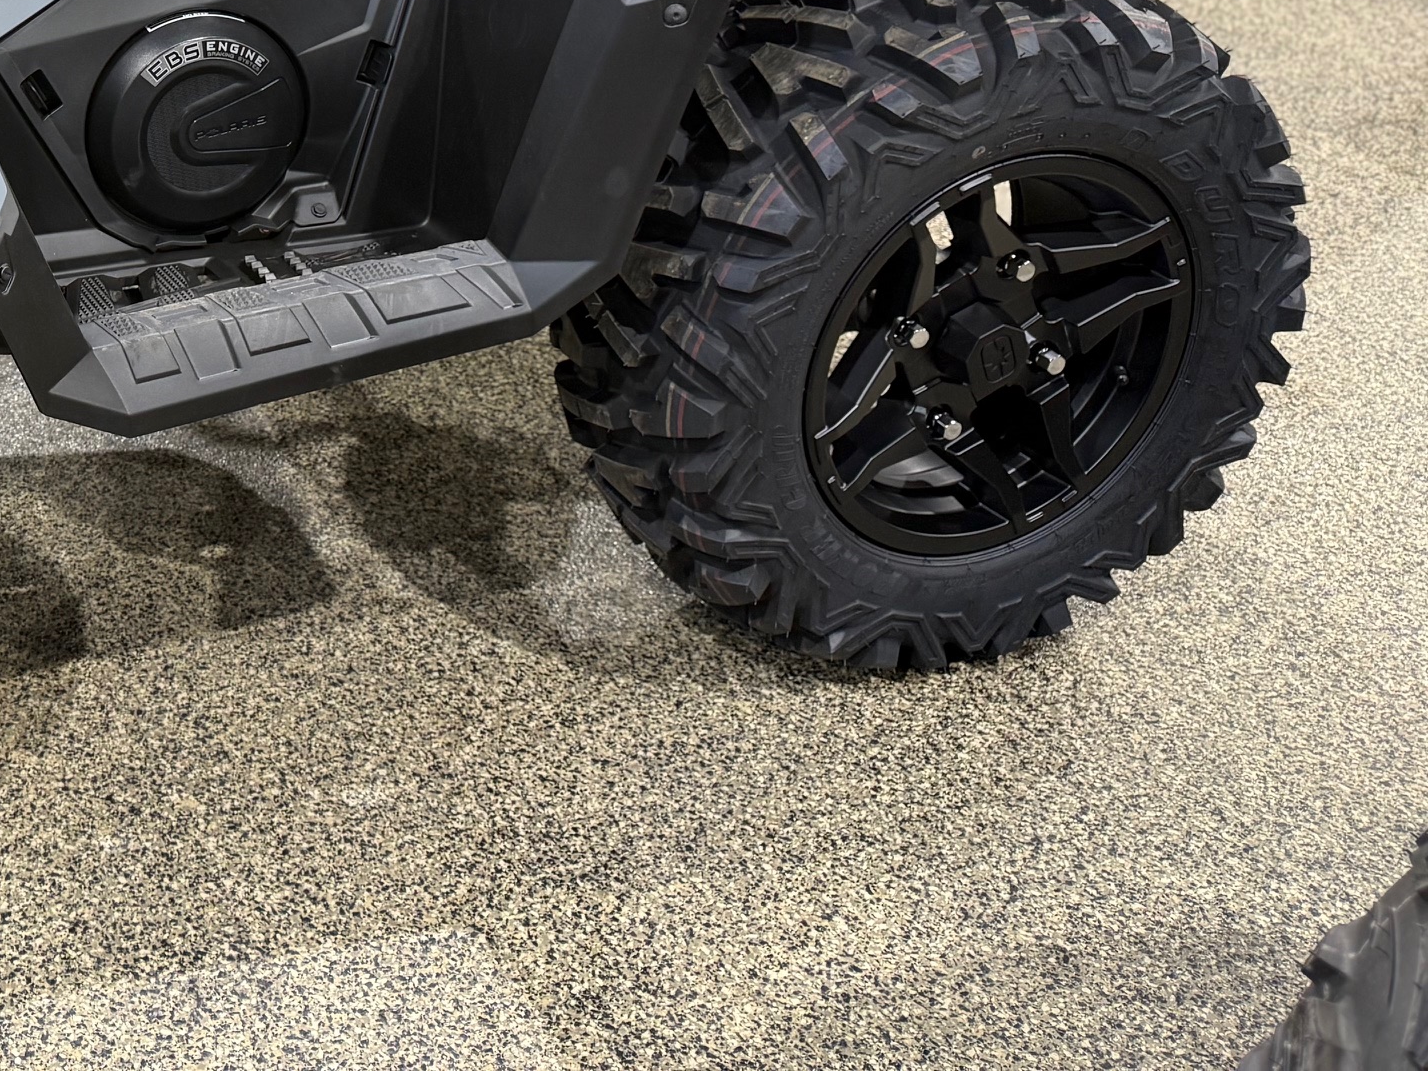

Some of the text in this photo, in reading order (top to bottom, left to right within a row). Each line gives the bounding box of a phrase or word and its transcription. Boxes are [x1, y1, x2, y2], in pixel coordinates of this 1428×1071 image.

[147, 41, 265, 82] EBS ENGINE
[207, 51, 235, 59] BRAKING
